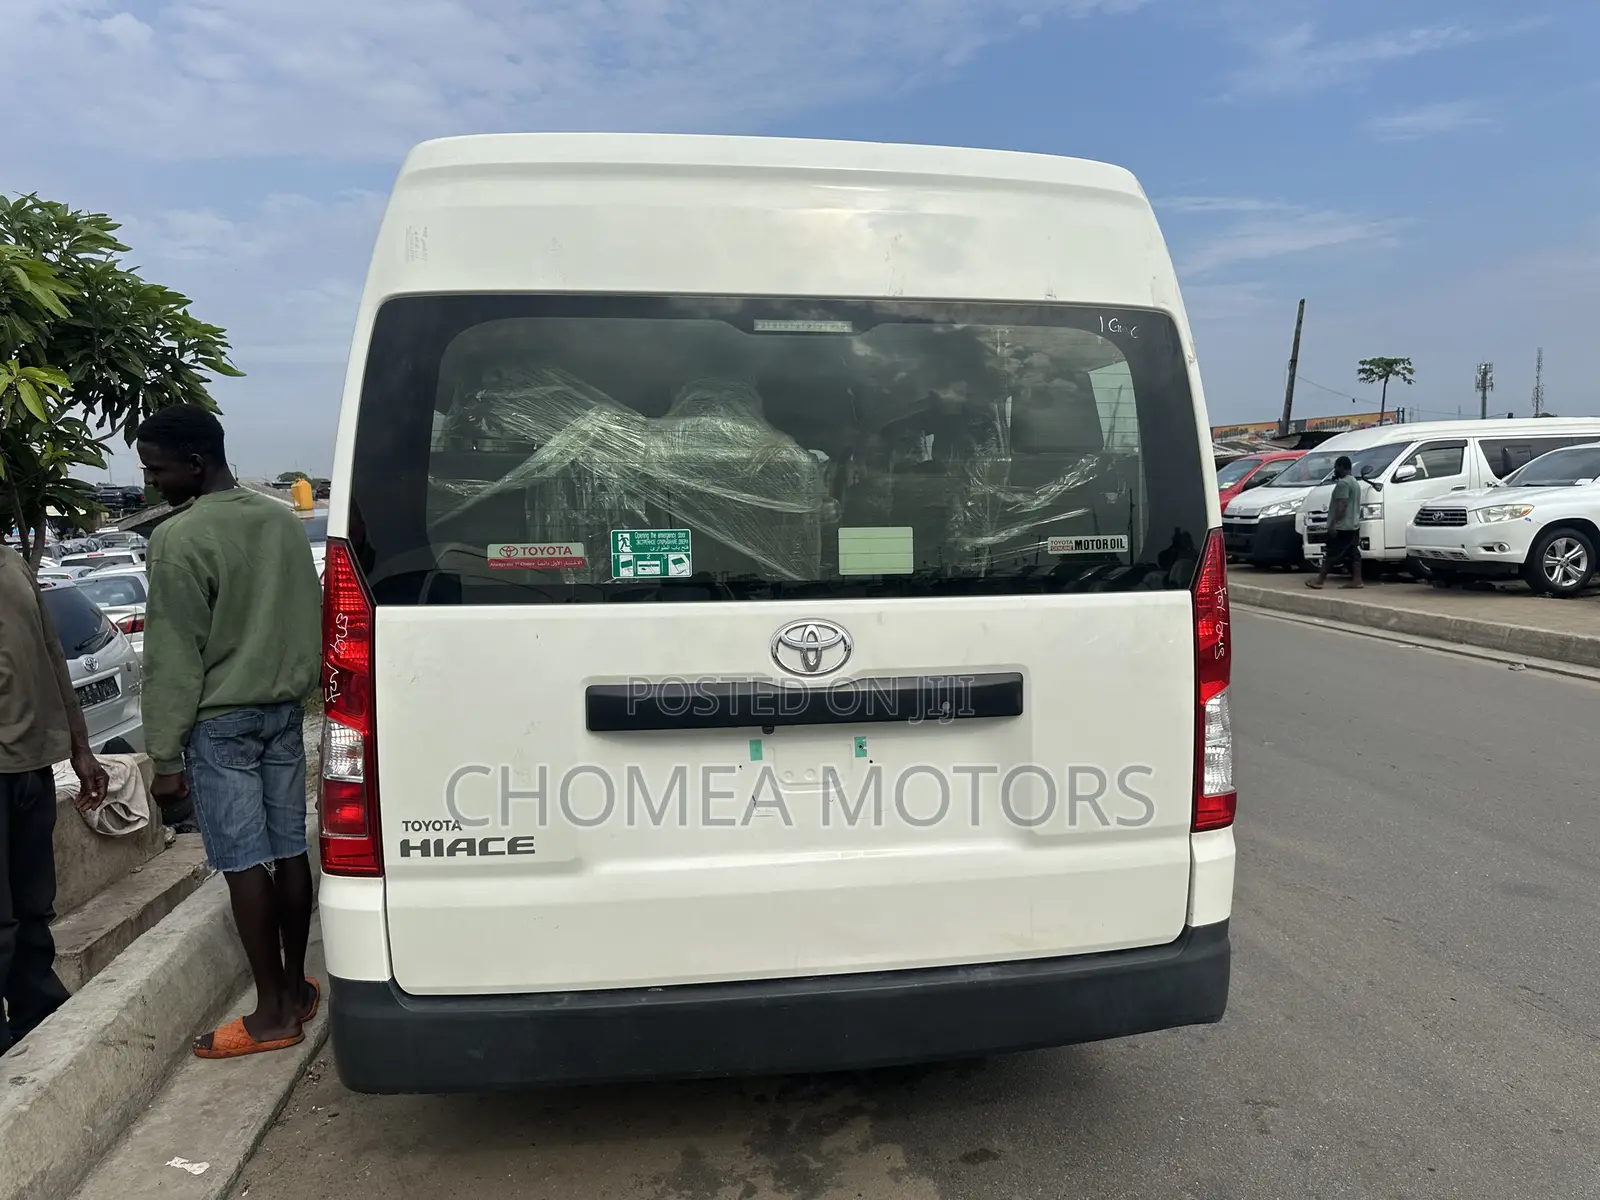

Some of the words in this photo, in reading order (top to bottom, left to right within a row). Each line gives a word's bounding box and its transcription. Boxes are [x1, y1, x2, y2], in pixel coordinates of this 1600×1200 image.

[1074, 538, 1109, 551] MOTOR
[1110, 537, 1125, 549] OIL
[520, 546, 572, 556] TOYOTA
[402, 819, 463, 832] TOYOTA
[399, 835, 536, 858] HIACE
